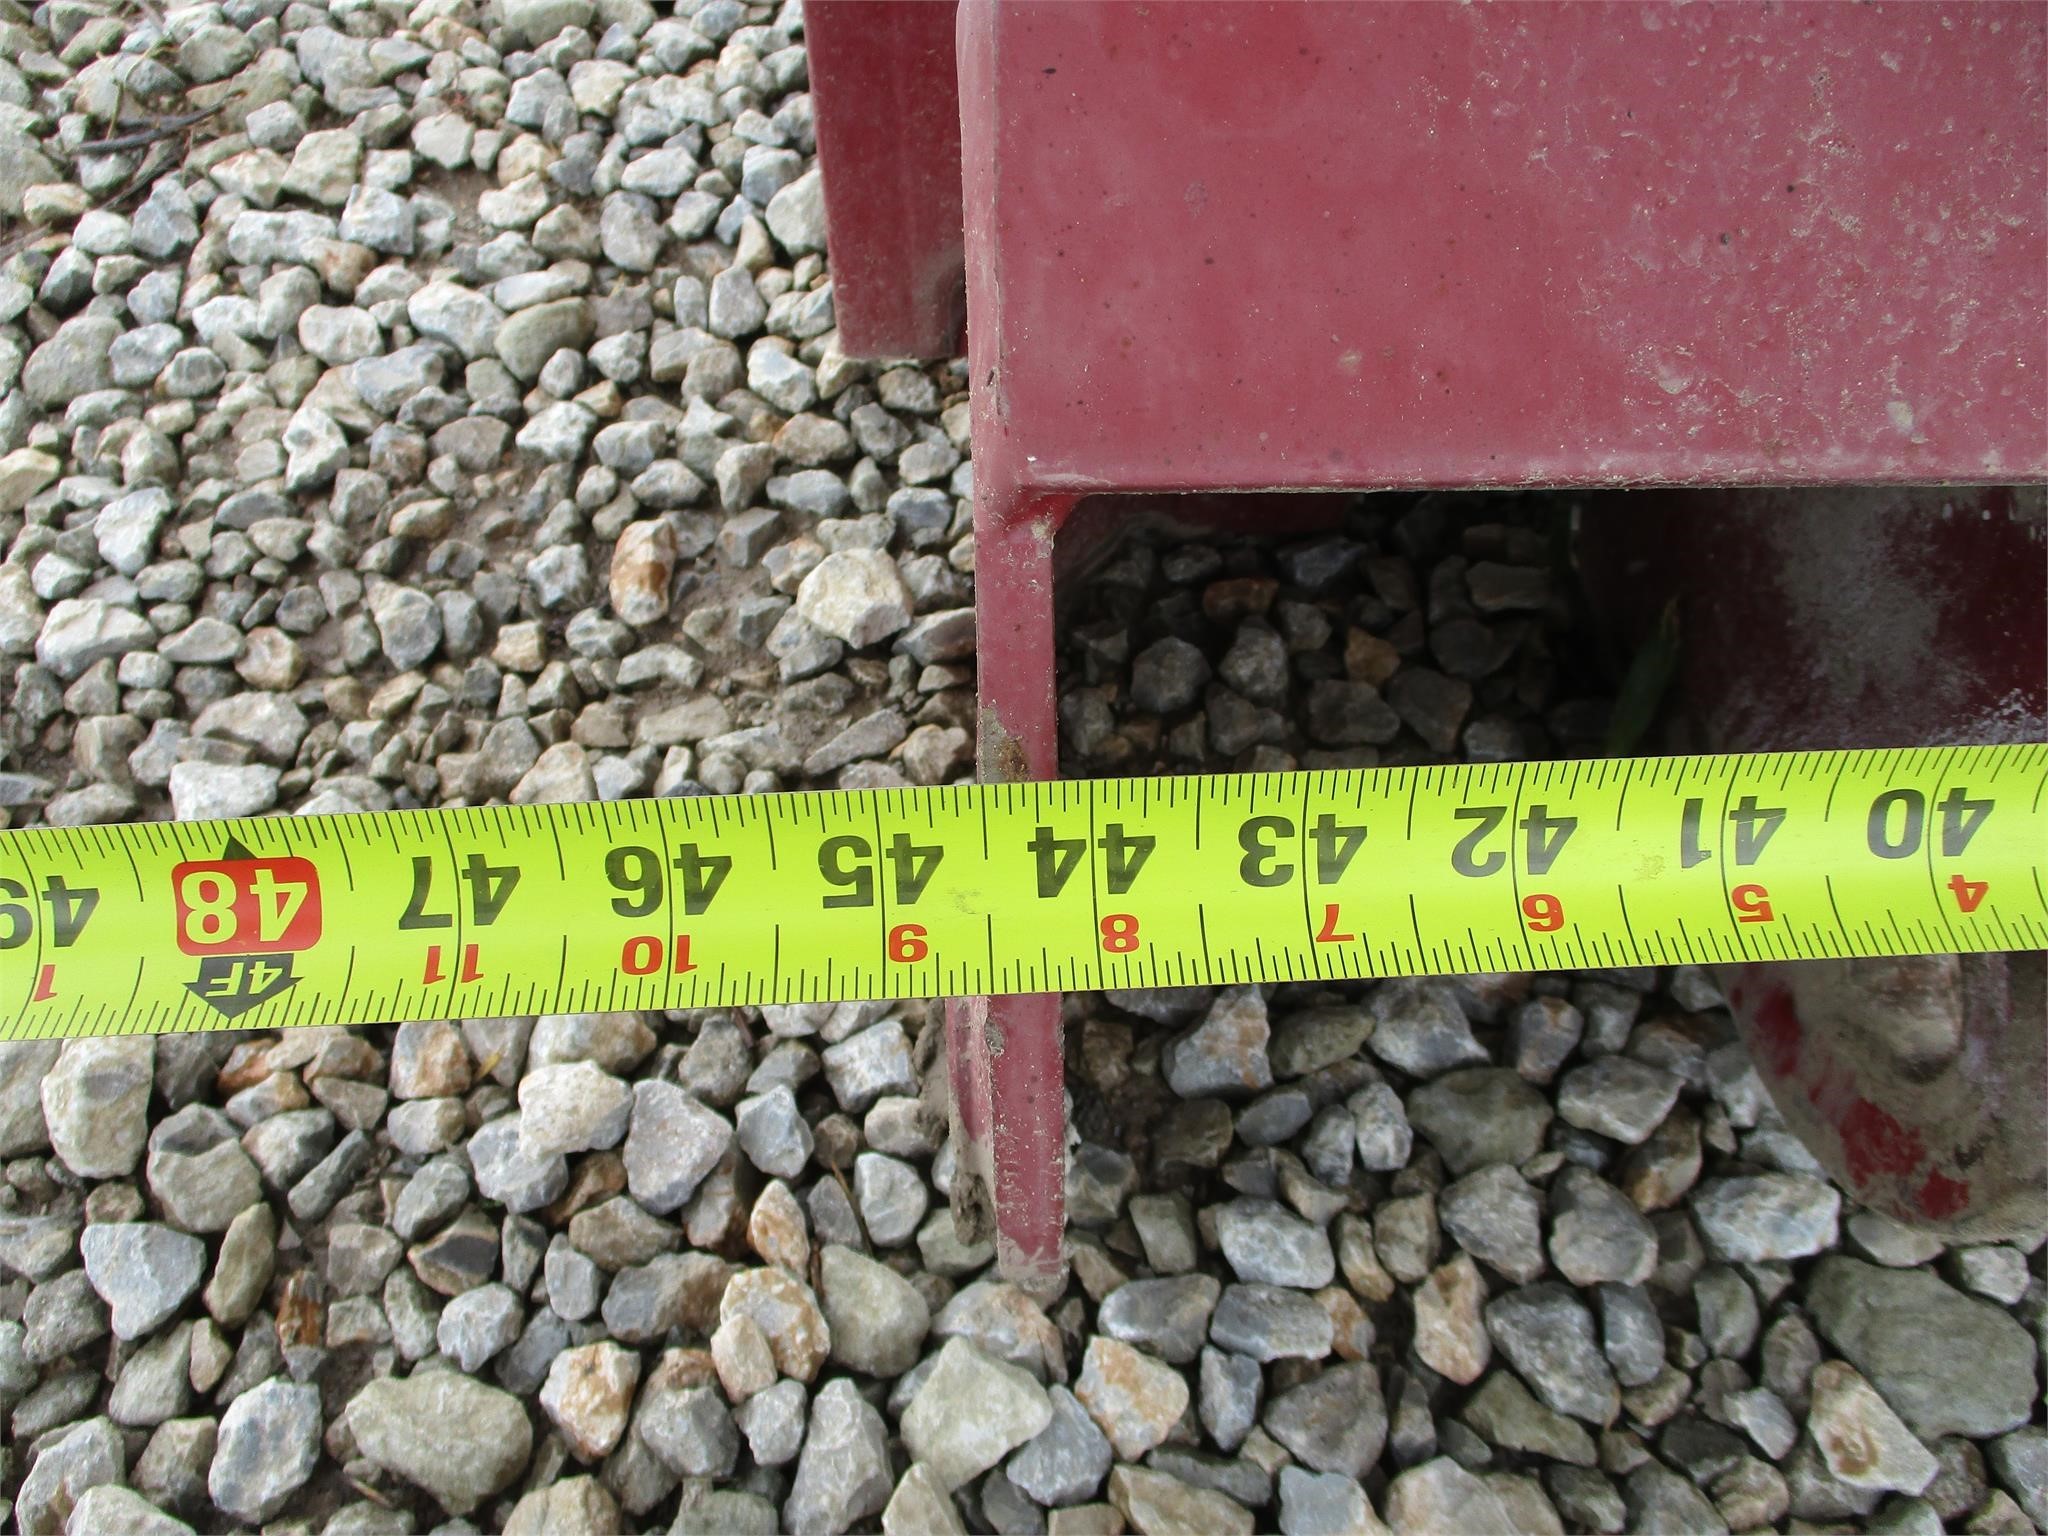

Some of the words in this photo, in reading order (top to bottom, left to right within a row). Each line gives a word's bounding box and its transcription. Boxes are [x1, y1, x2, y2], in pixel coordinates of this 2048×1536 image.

[1451, 804, 1578, 878] 42
[1680, 795, 1787, 869] 41
[1867, 786, 1995, 859] 40
[817, 833, 944, 908] 45
[1027, 823, 1156, 898] 44
[1238, 813, 1368, 887] 43
[398, 853, 521, 930] 47
[604, 843, 732, 918] 46
[1947, 874, 1989, 913] 4
[181, 868, 308, 945] 48
[1316, 903, 1355, 943] 7
[1522, 893, 1565, 933] 6
[1731, 883, 1774, 923] 5
[888, 923, 928, 962] 9
[1100, 913, 1140, 953] 8
[422, 942, 485, 985] 11
[621, 934, 698, 976] 10
[33, 963, 57, 1002] 1
[203, 958, 285, 997] 4F
